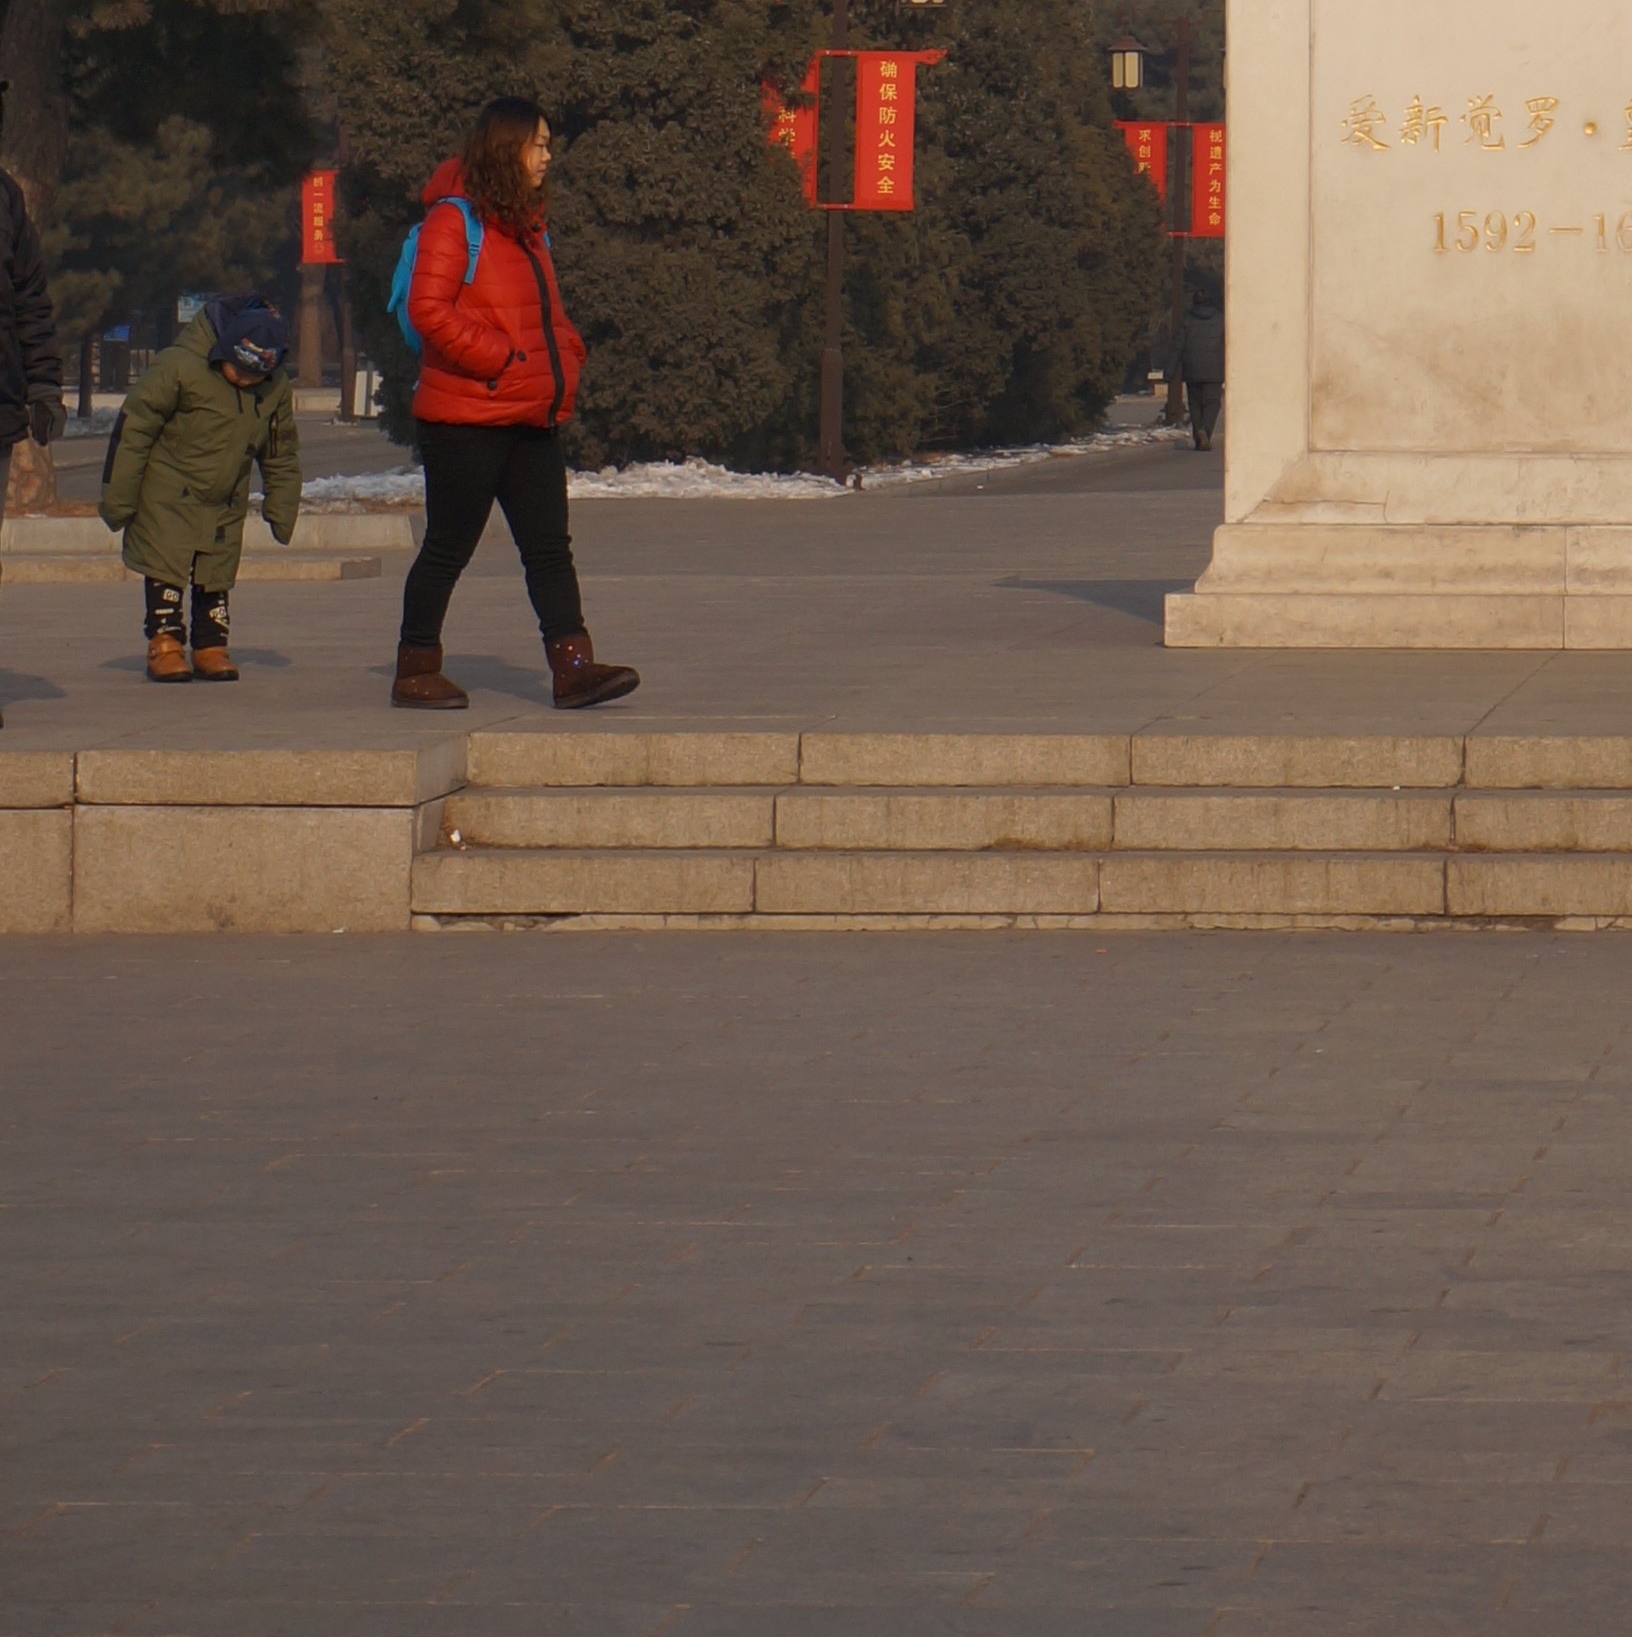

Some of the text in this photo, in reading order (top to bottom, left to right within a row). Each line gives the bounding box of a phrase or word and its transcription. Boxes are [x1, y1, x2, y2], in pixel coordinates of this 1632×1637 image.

[877, 61, 897, 194] 确保防火安全
[1208, 129, 1223, 226] 视遗产为生命
